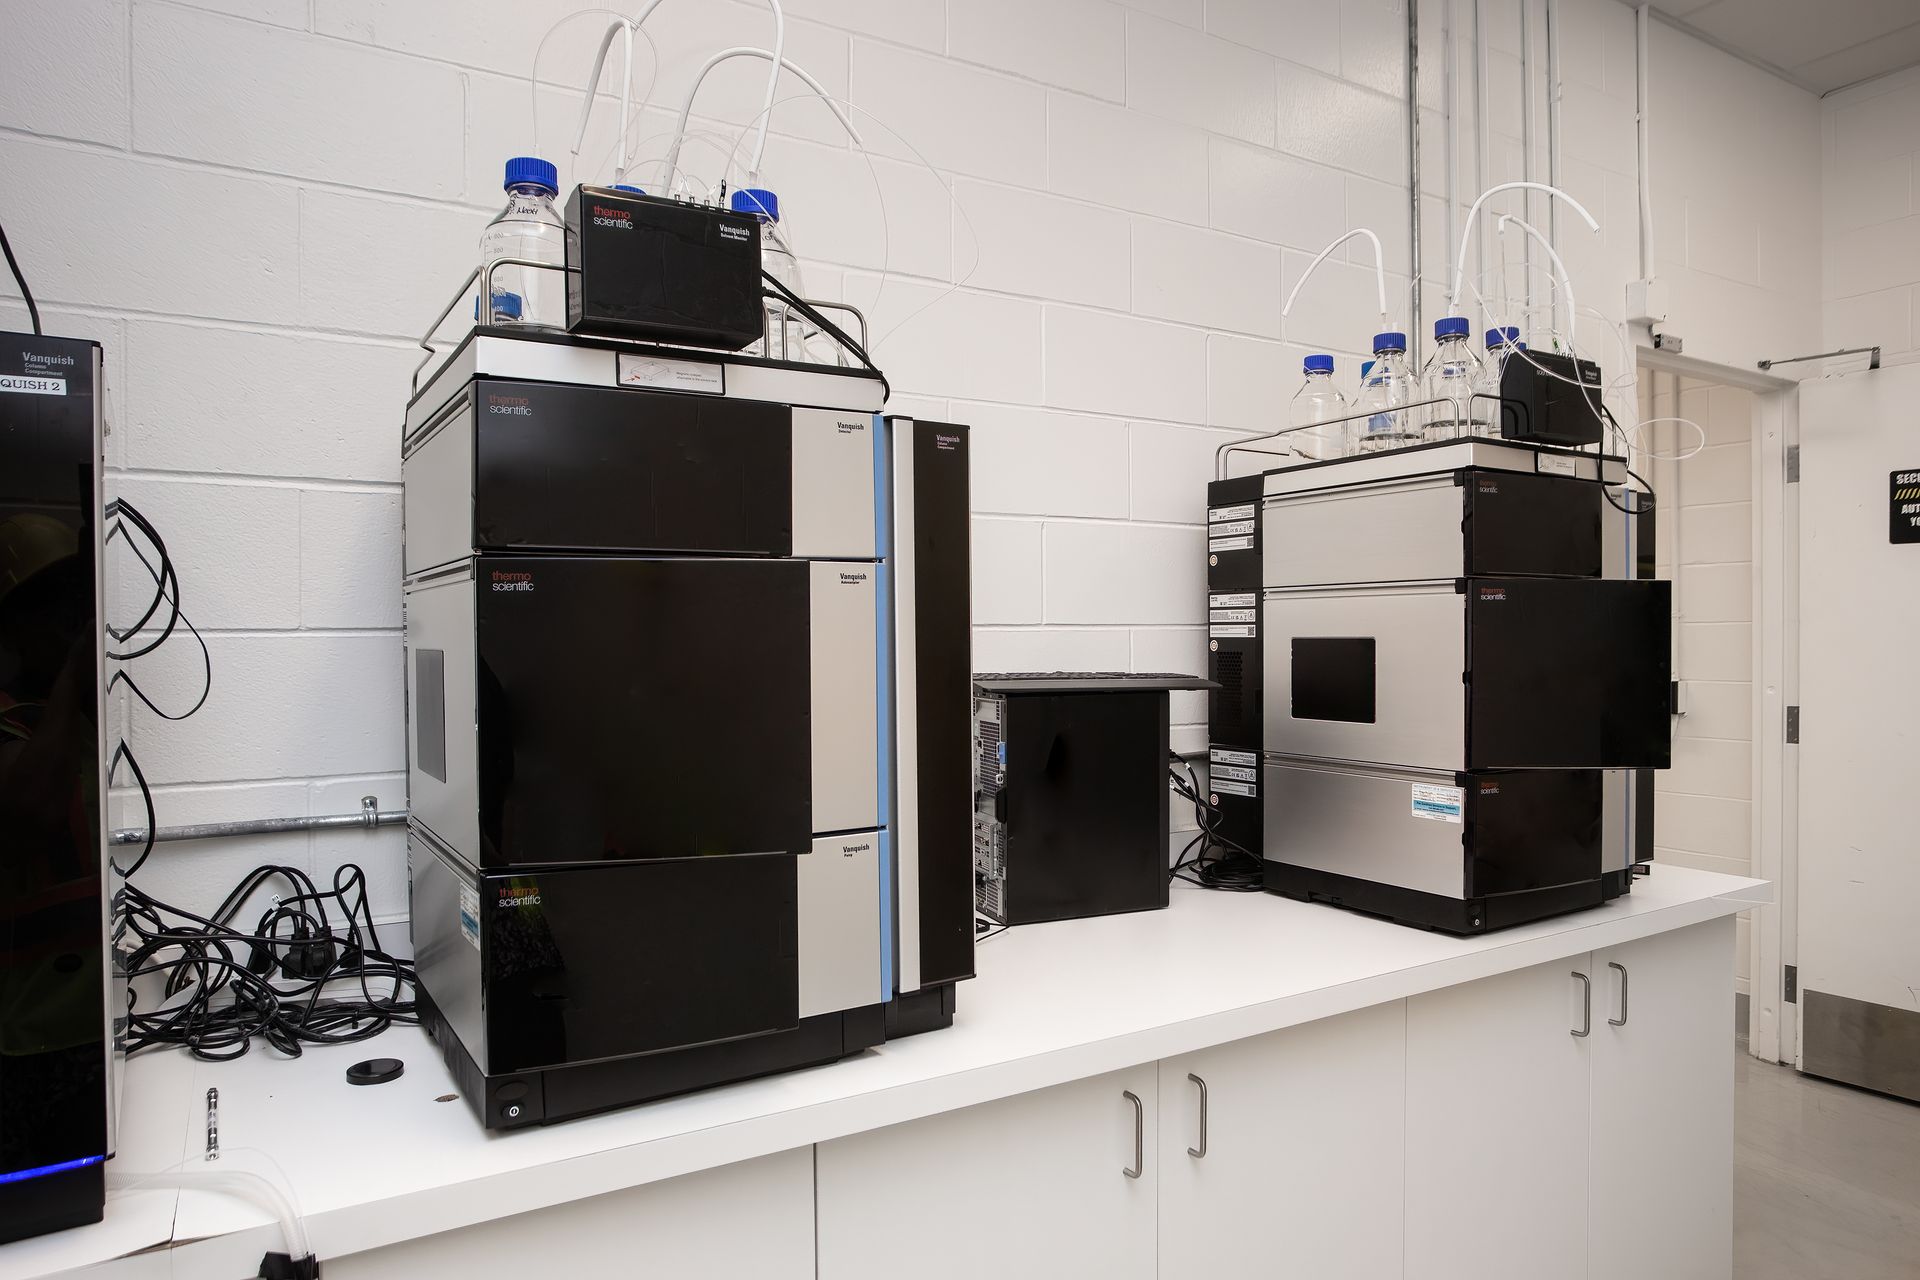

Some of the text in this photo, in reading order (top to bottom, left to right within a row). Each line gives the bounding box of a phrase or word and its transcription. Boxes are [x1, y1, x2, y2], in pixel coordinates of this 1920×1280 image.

[593, 205, 631, 219] thermo
[593, 217, 633, 230] scientific
[719, 224, 750, 236] Vanquish
[22, 352, 74, 366] Vanquish
[0, 378, 60, 391] QUISH 2
[490, 405, 532, 416] scientific
[837, 422, 864, 431] Vanquish
[492, 570, 532, 581] thermo
[840, 572, 867, 581] Vanquish
[492, 581, 534, 591] scientific
[843, 843, 870, 853] Vanquish
[499, 887, 540, 897] thermo
[498, 895, 541, 908] scientific
